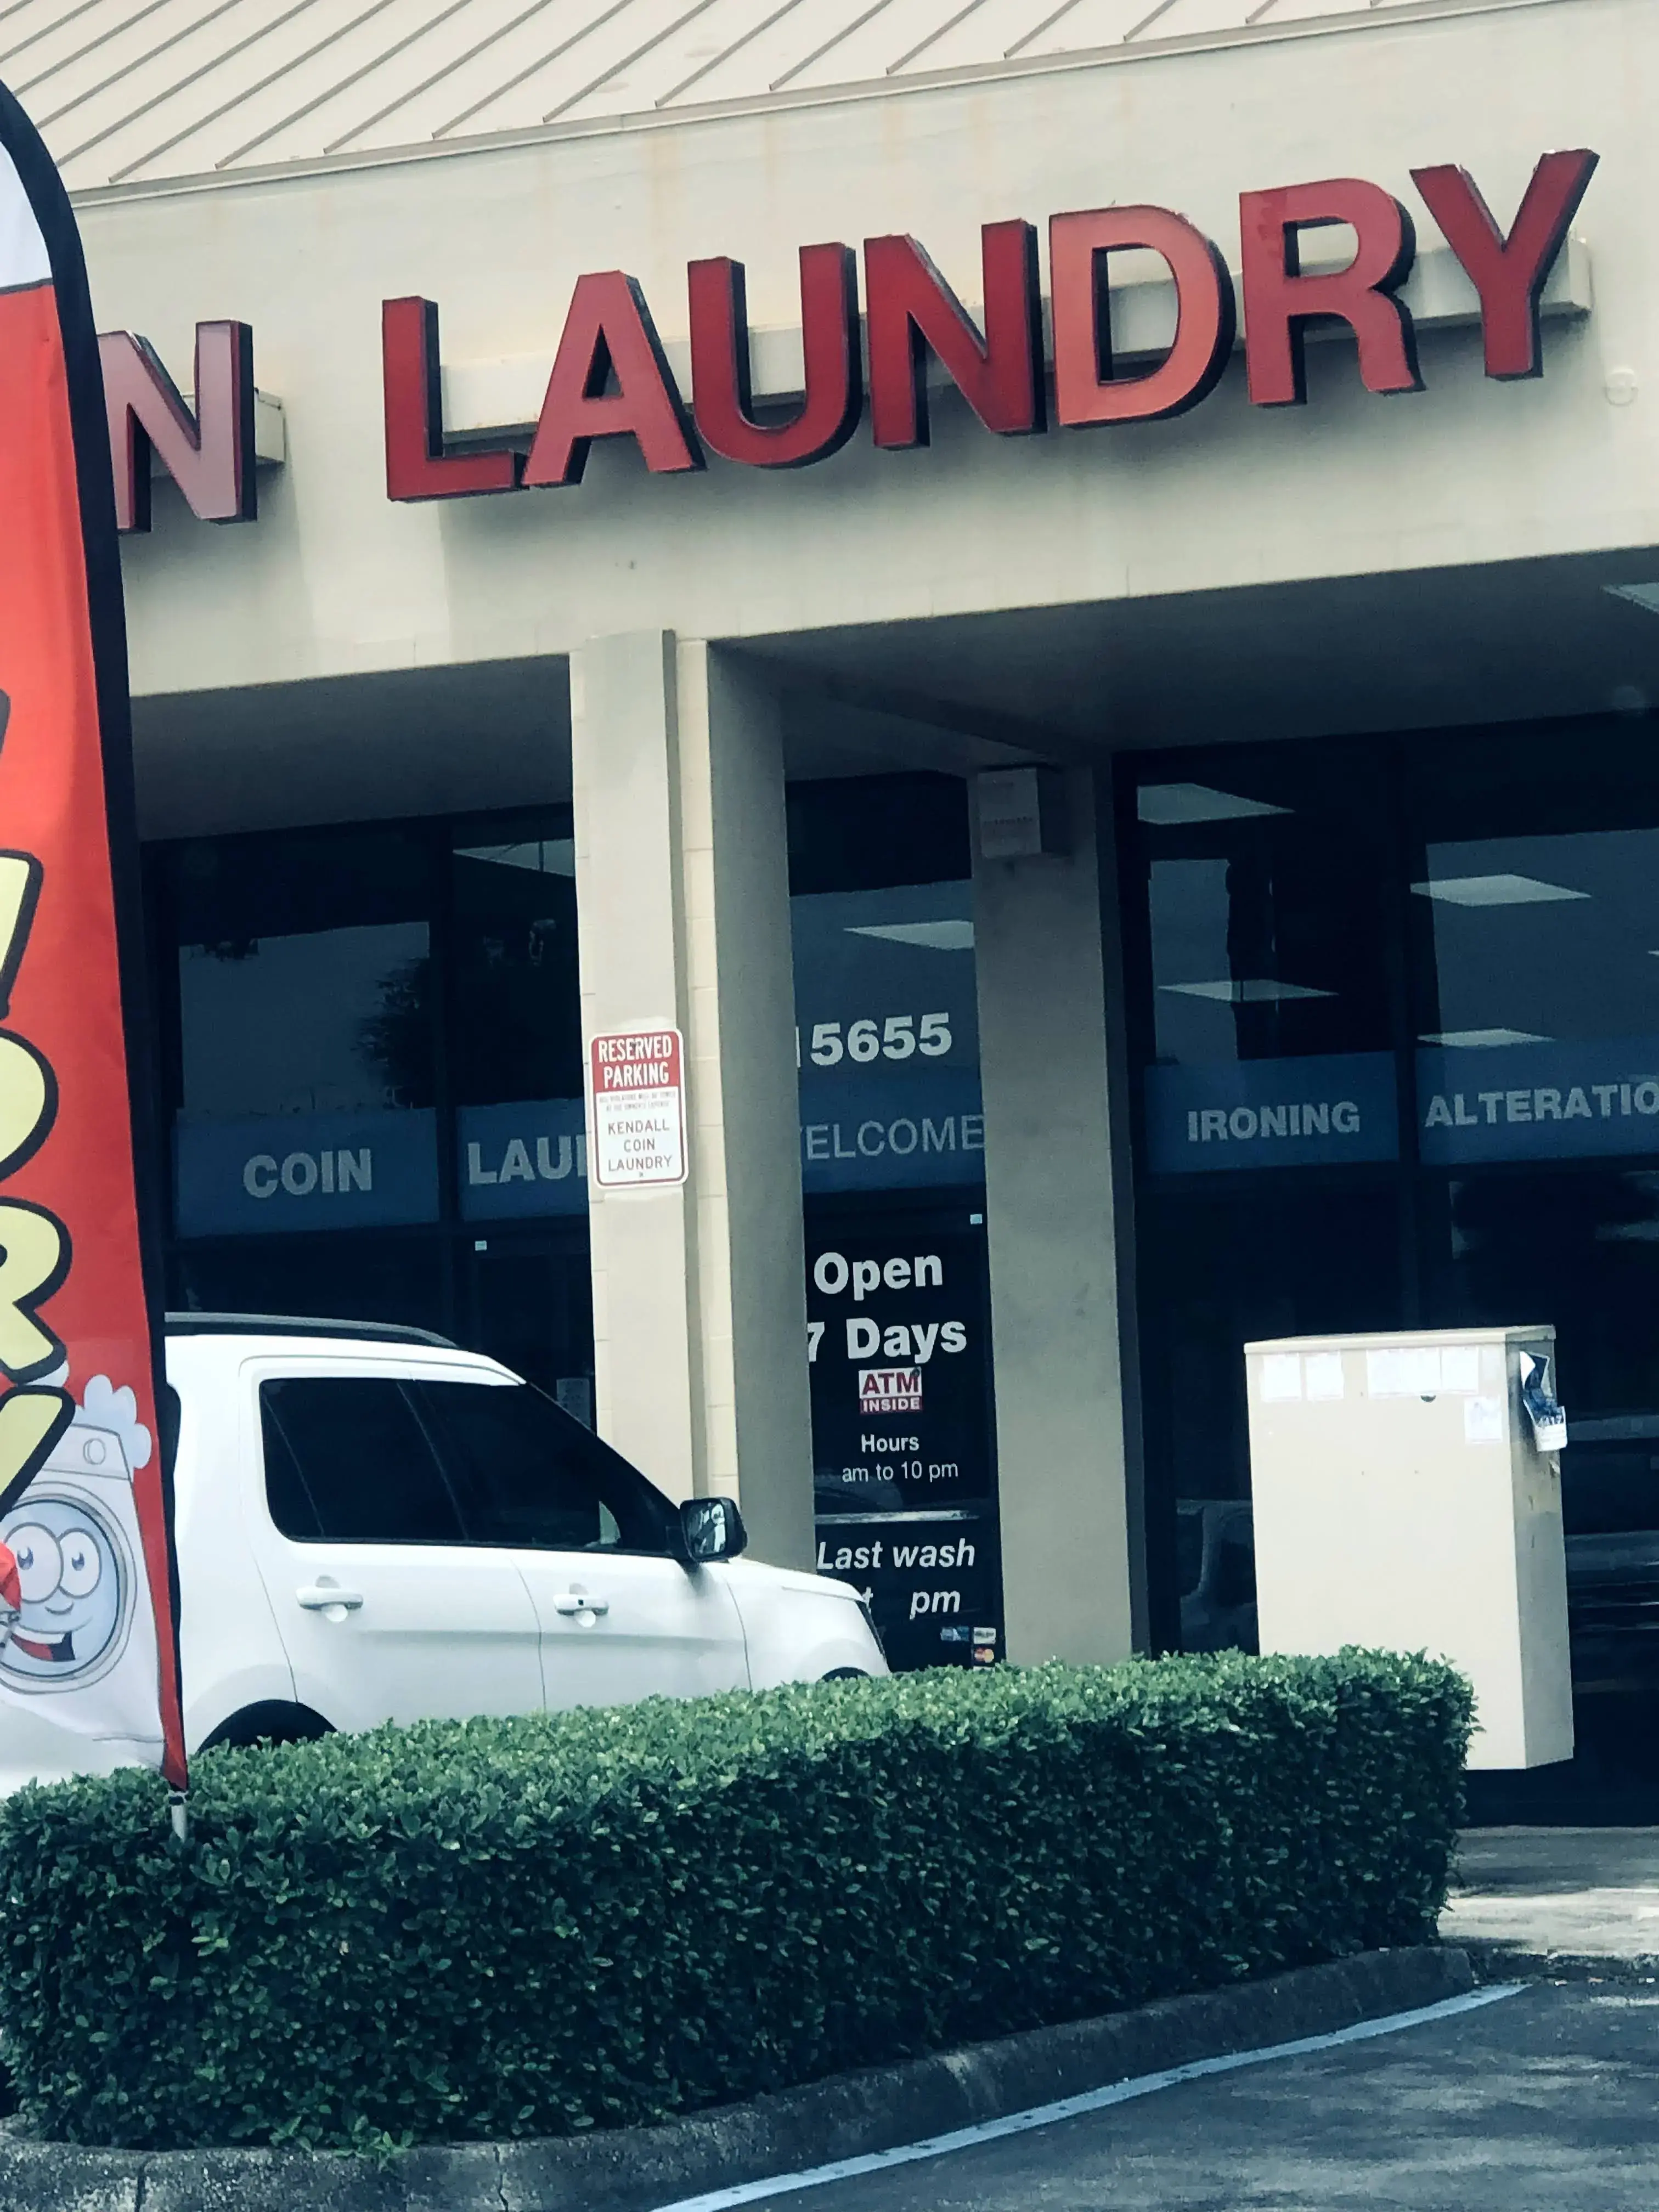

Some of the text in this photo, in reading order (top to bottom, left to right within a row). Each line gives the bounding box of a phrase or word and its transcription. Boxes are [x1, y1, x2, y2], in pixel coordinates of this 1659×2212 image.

[381, 148, 1600, 502] LAUNDRY
[597, 1035, 673, 1064] RESERVED
[602, 1062, 670, 1090] PARKING
[1425, 1081, 1659, 1129] ALTERATIO
[607, 1119, 670, 1136] KENDALL
[800, 1114, 985, 1160] ELCOME
[1187, 1101, 1361, 1143] IRONING
[623, 1138, 656, 1153] COIN
[242, 1147, 373, 1199] COIN
[607, 1154, 673, 1172] LAUNDRY
[814, 1251, 944, 1301] Open
[806, 1317, 967, 1364] 7 Days
[862, 1372, 920, 1396] ATM
[862, 1396, 921, 1413] INSIDE
[861, 1434, 920, 1454] Hours
[842, 1460, 958, 1483] am to 10 pm
[816, 1538, 975, 1570] Last wash
[909, 1589, 961, 1621] pm
